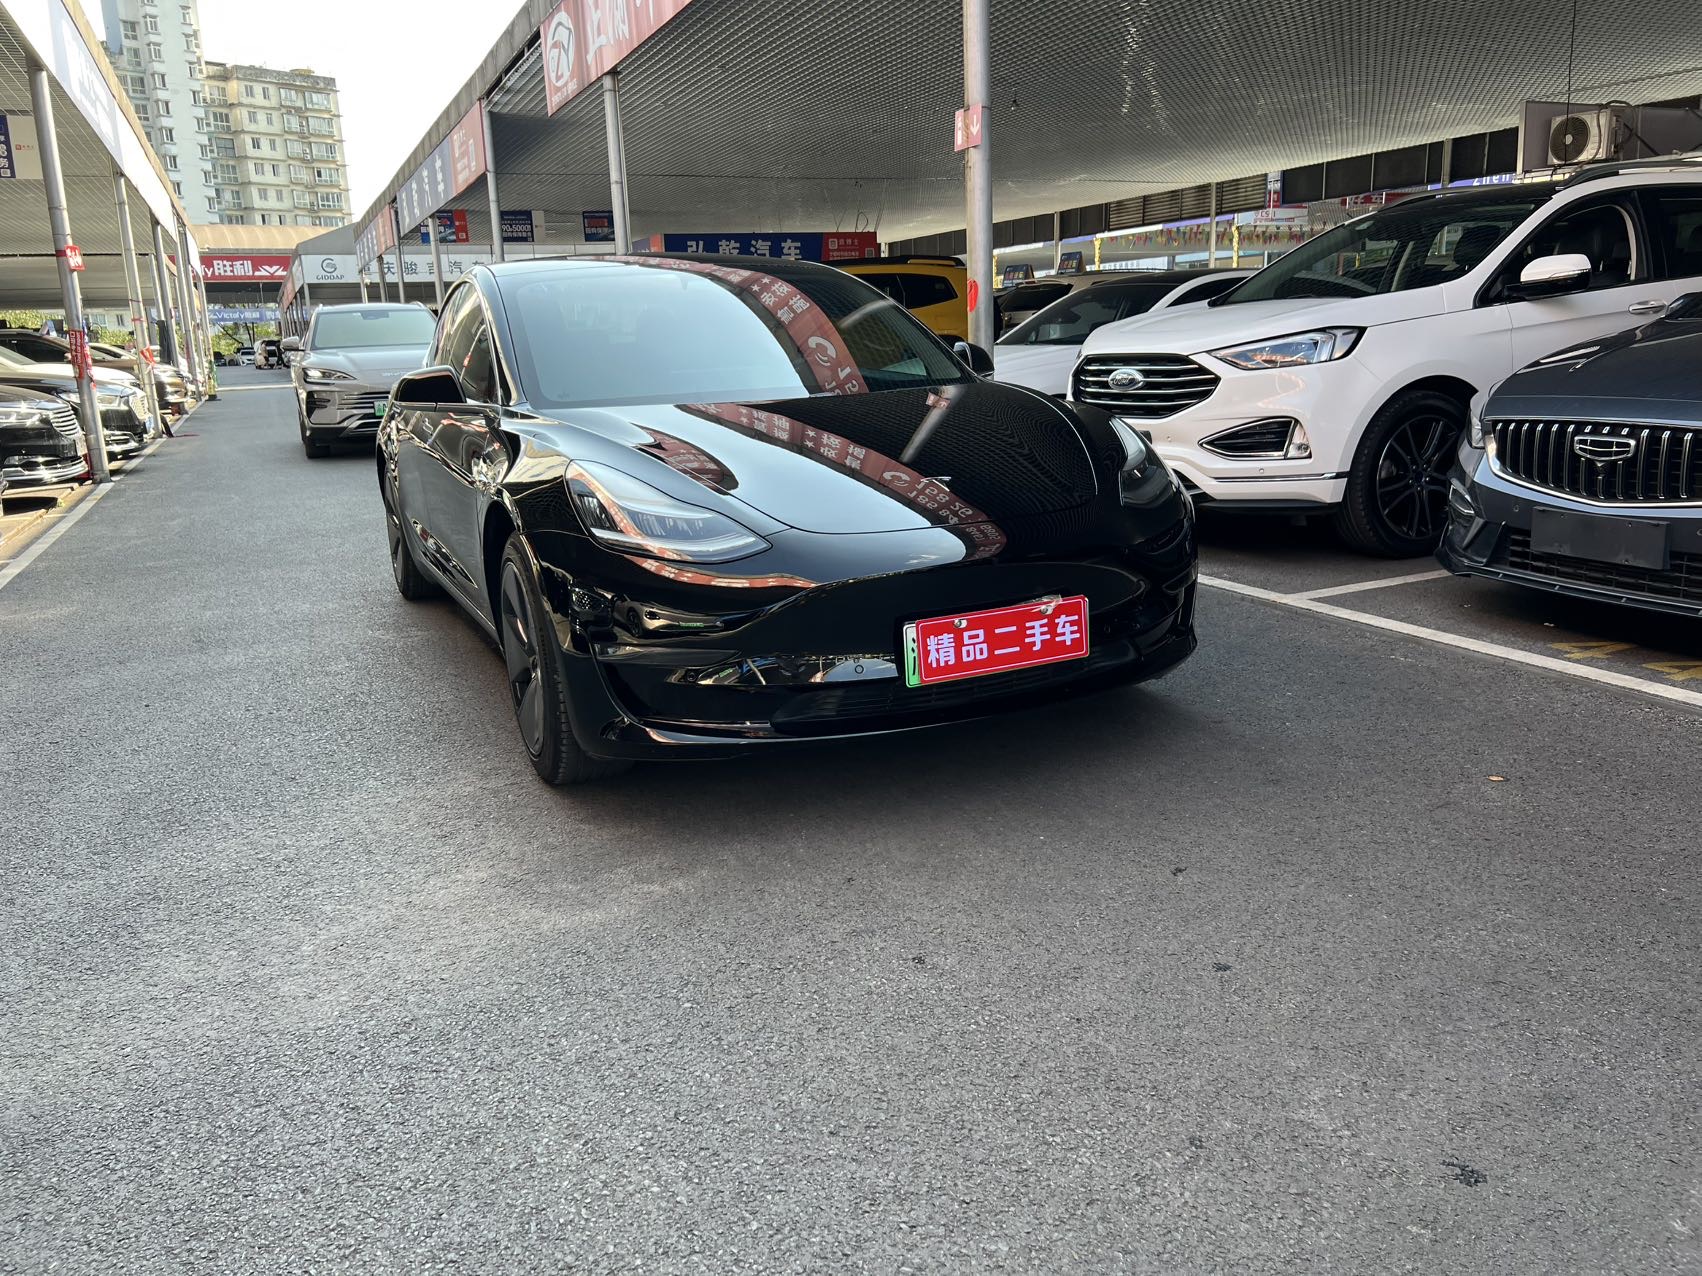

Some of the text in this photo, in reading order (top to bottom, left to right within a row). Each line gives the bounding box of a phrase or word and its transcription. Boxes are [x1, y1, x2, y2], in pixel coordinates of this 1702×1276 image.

[213, 260, 253, 276] 胜利
[927, 614, 1081, 668] 精品二手车
